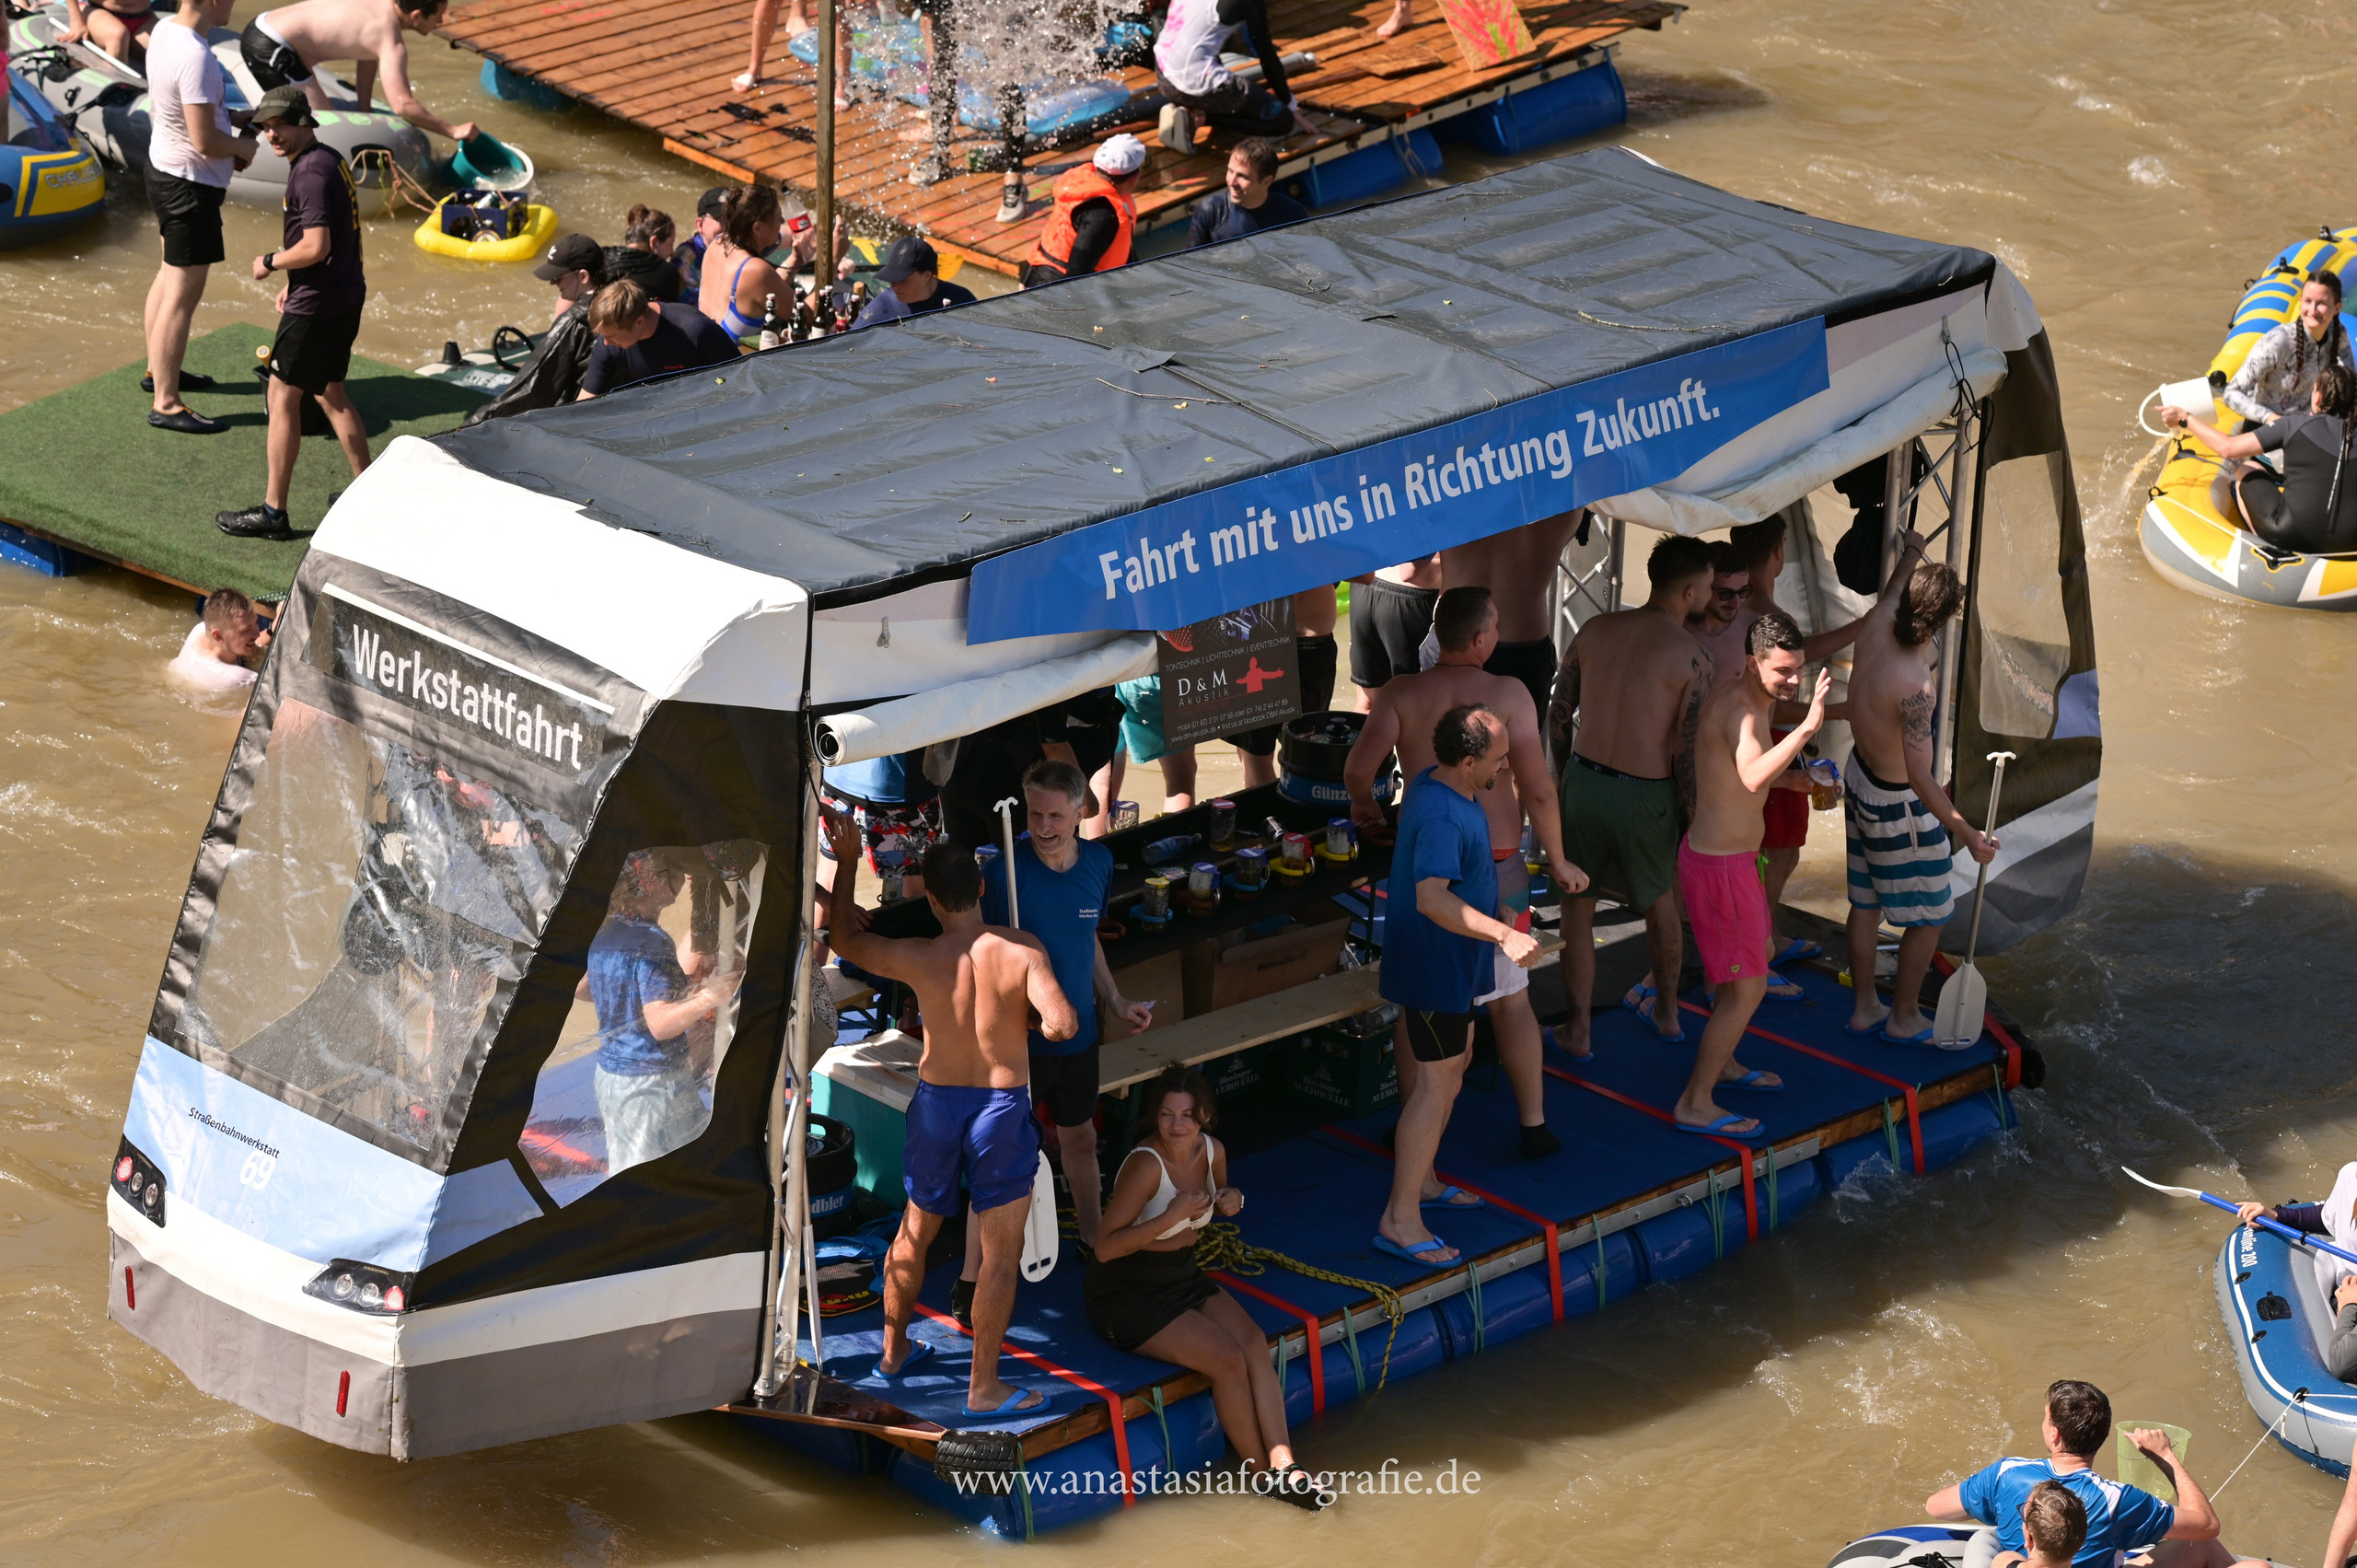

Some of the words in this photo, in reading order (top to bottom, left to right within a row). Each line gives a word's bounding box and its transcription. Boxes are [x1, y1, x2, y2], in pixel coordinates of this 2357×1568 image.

[44, 165, 98, 189] CHALLE
[1098, 528, 1200, 600] Fahrt
[1209, 505, 1279, 567] mit
[1289, 494, 1353, 544] uns
[1359, 474, 1397, 524] in
[1404, 429, 1573, 510] Richtung
[1576, 377, 1721, 458] Zukunft.
[1166, 657, 1202, 672] TONTECHNIK
[1206, 646, 1245, 663] LICHTTECHNIK
[1249, 636, 1291, 653] EVENTTECHNIK
[1178, 678, 1190, 696] D
[1197, 678, 1207, 691] &
[1213, 668, 1227, 689] M
[353, 623, 584, 771] Werkstattfahrt
[1178, 688, 1229, 708] Akustik
[1177, 722, 1191, 732] mobil
[1234, 709, 1246, 719] oder
[1243, 714, 1266, 726] facebook
[188, 1107, 281, 1159] Straßenbahnwerkstatt
[239, 1149, 276, 1191] 69
[2240, 1251, 2258, 1268] 200
